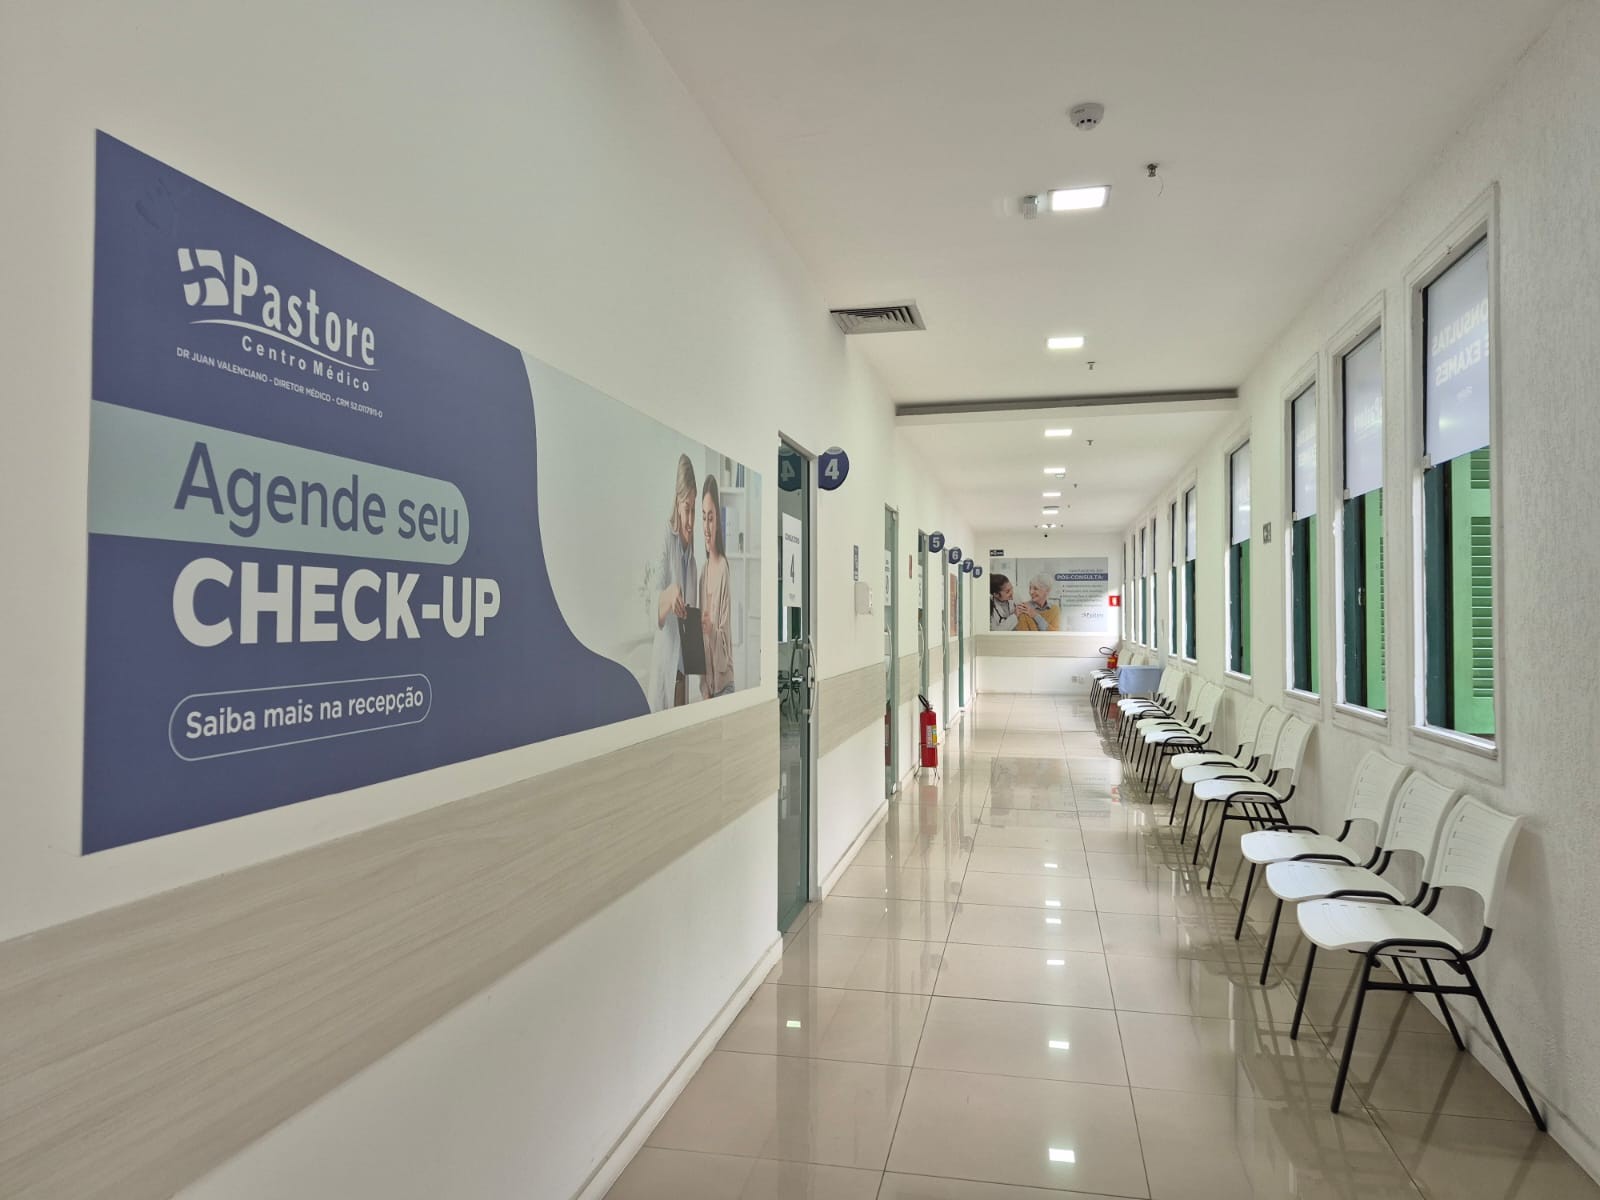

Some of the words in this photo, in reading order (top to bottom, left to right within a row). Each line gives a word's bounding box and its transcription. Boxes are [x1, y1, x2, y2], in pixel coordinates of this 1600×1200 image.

[233, 254, 376, 366] Pastore
[176, 346, 191, 360] DR
[191, 352, 216, 367] JUAN
[216, 359, 269, 383] VALENCIANO
[273, 377, 305, 394] DIRETOR
[305, 385, 332, 402] MÉDICO
[335, 396, 350, 409] CRM
[240, 334, 307, 370] Centro
[313, 360, 370, 392] Médico
[173, 441, 386, 538] Agende
[398, 498, 459, 545] seu
[824, 458, 840, 480] 4
[932, 537, 940, 548] 5
[951, 550, 959, 560] 6
[965, 561, 971, 570] 7
[172, 557, 501, 648] CHECK-UP
[185, 706, 256, 740] Saiba
[263, 698, 313, 728] mais
[319, 700, 342, 721] na
[348, 686, 424, 716] recepção
